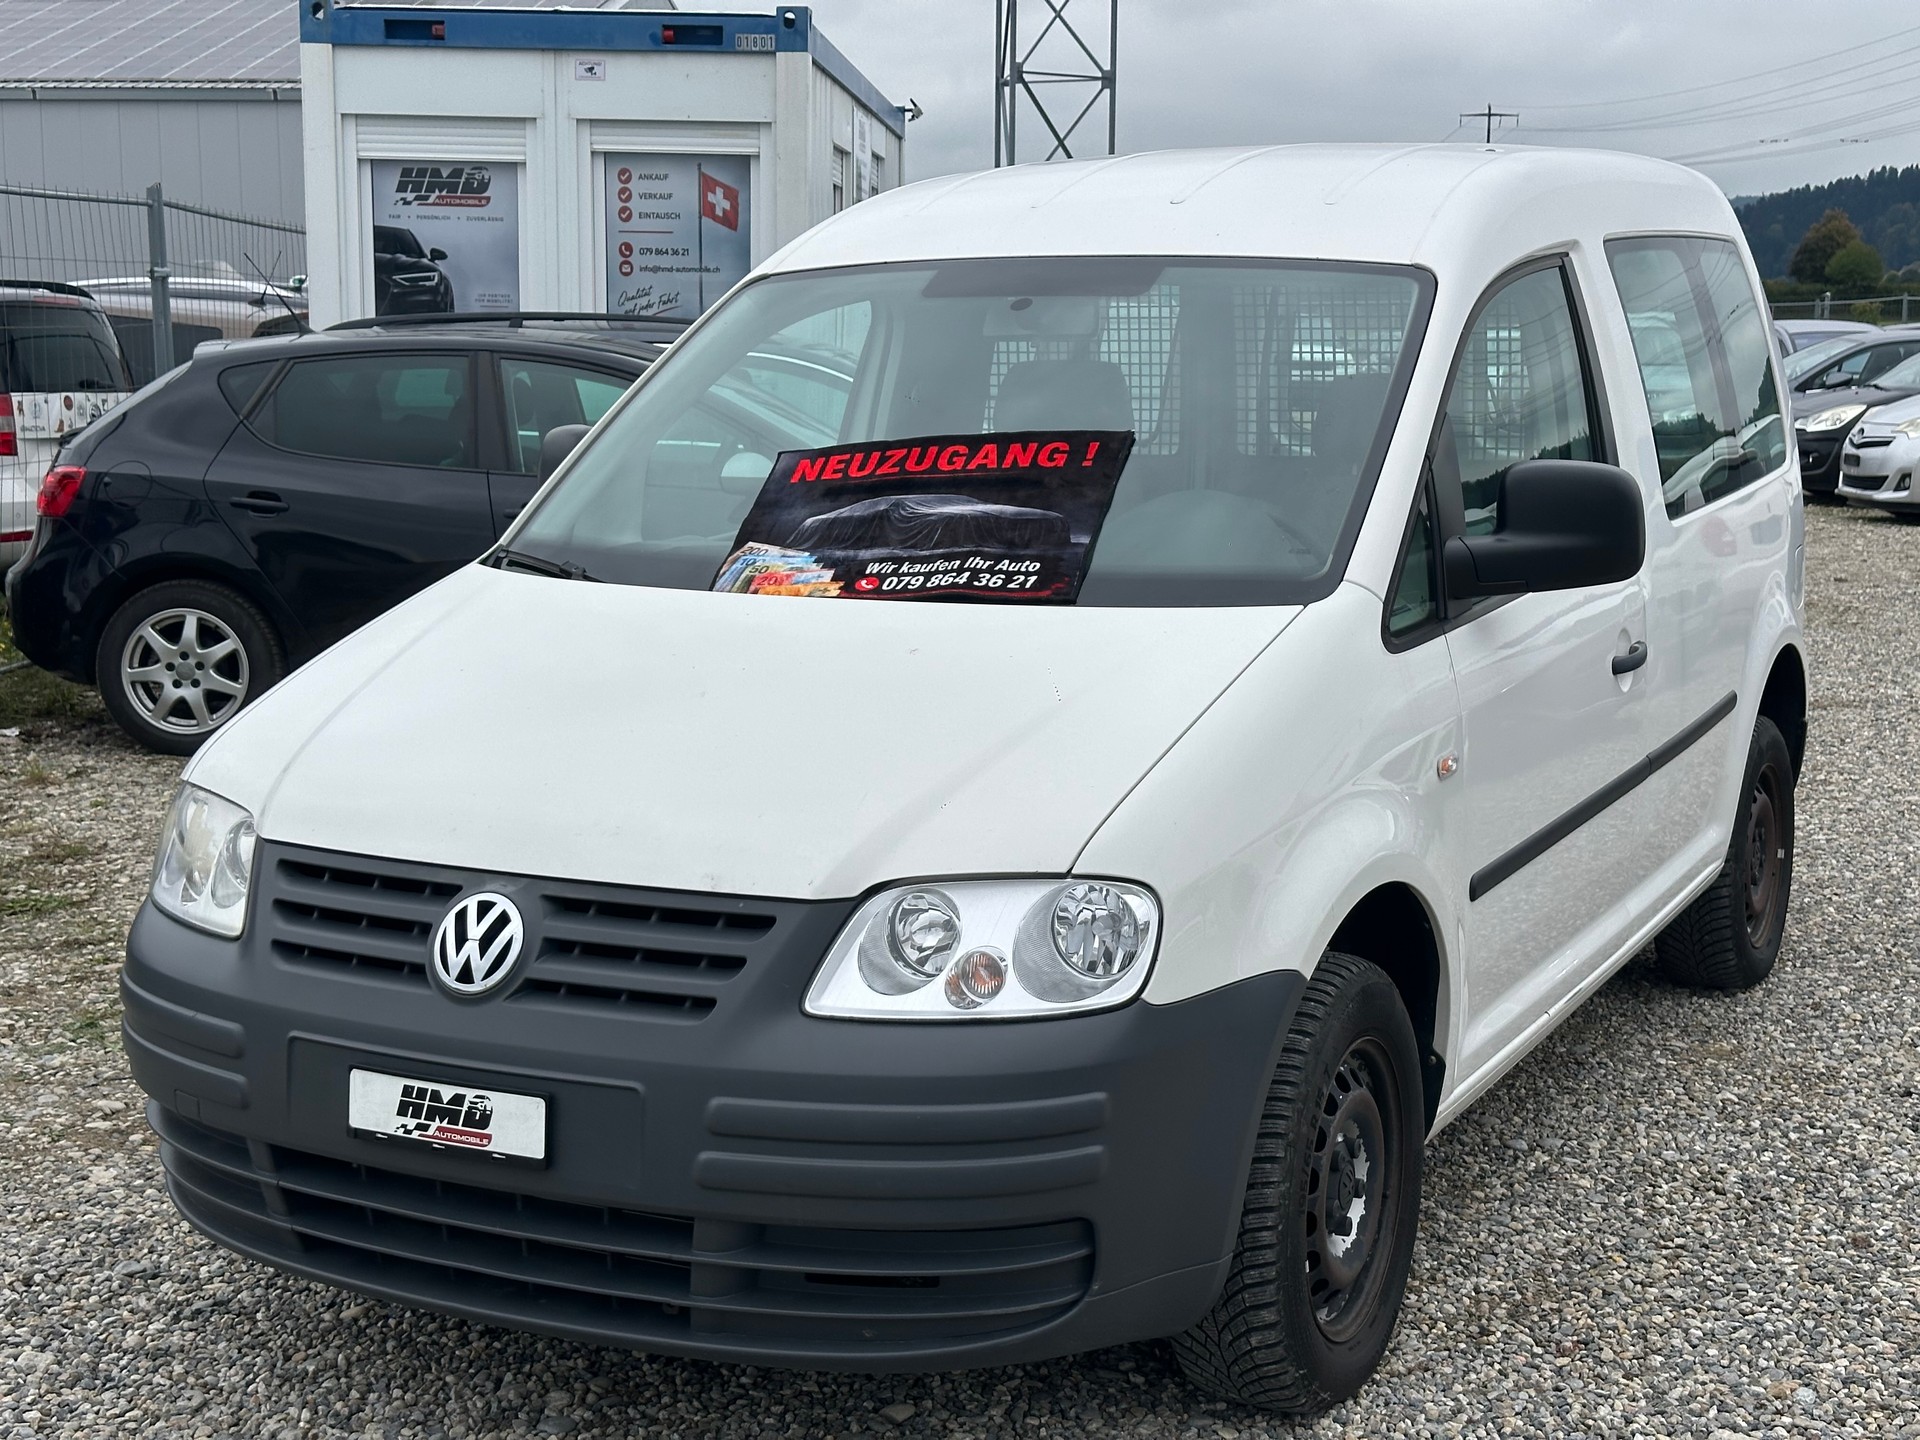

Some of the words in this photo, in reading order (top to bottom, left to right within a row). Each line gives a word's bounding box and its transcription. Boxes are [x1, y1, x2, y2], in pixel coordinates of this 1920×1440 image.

[736, 35, 775, 49] 01801
[395, 166, 491, 195] HMD
[638, 173, 669, 181] ANKAUF
[434, 197, 488, 205] AUTOMOBILE
[638, 192, 673, 201] VERKAUF
[638, 211, 681, 220] EINTAUSCH
[639, 247, 653, 256] 079
[655, 247, 669, 256] 864
[671, 248, 680, 256] 36
[681, 248, 689, 256] 21
[639, 265, 720, 274] info@hmd-automobile.ch
[657, 291, 680, 310] Fahrt
[790, 441, 1070, 484] NEUZUGANG
[749, 565, 770, 574] 50
[865, 561, 898, 575] Wir
[898, 558, 962, 575] kaufen
[964, 556, 994, 569] Ihr
[994, 559, 1042, 572] Auto
[881, 575, 925, 591] 079
[926, 571, 971, 588] 864
[973, 573, 1006, 588] 36
[1007, 575, 1039, 589] 21
[396, 1084, 493, 1131] HMD
[433, 1130, 489, 1145] AUTOMOBILE
